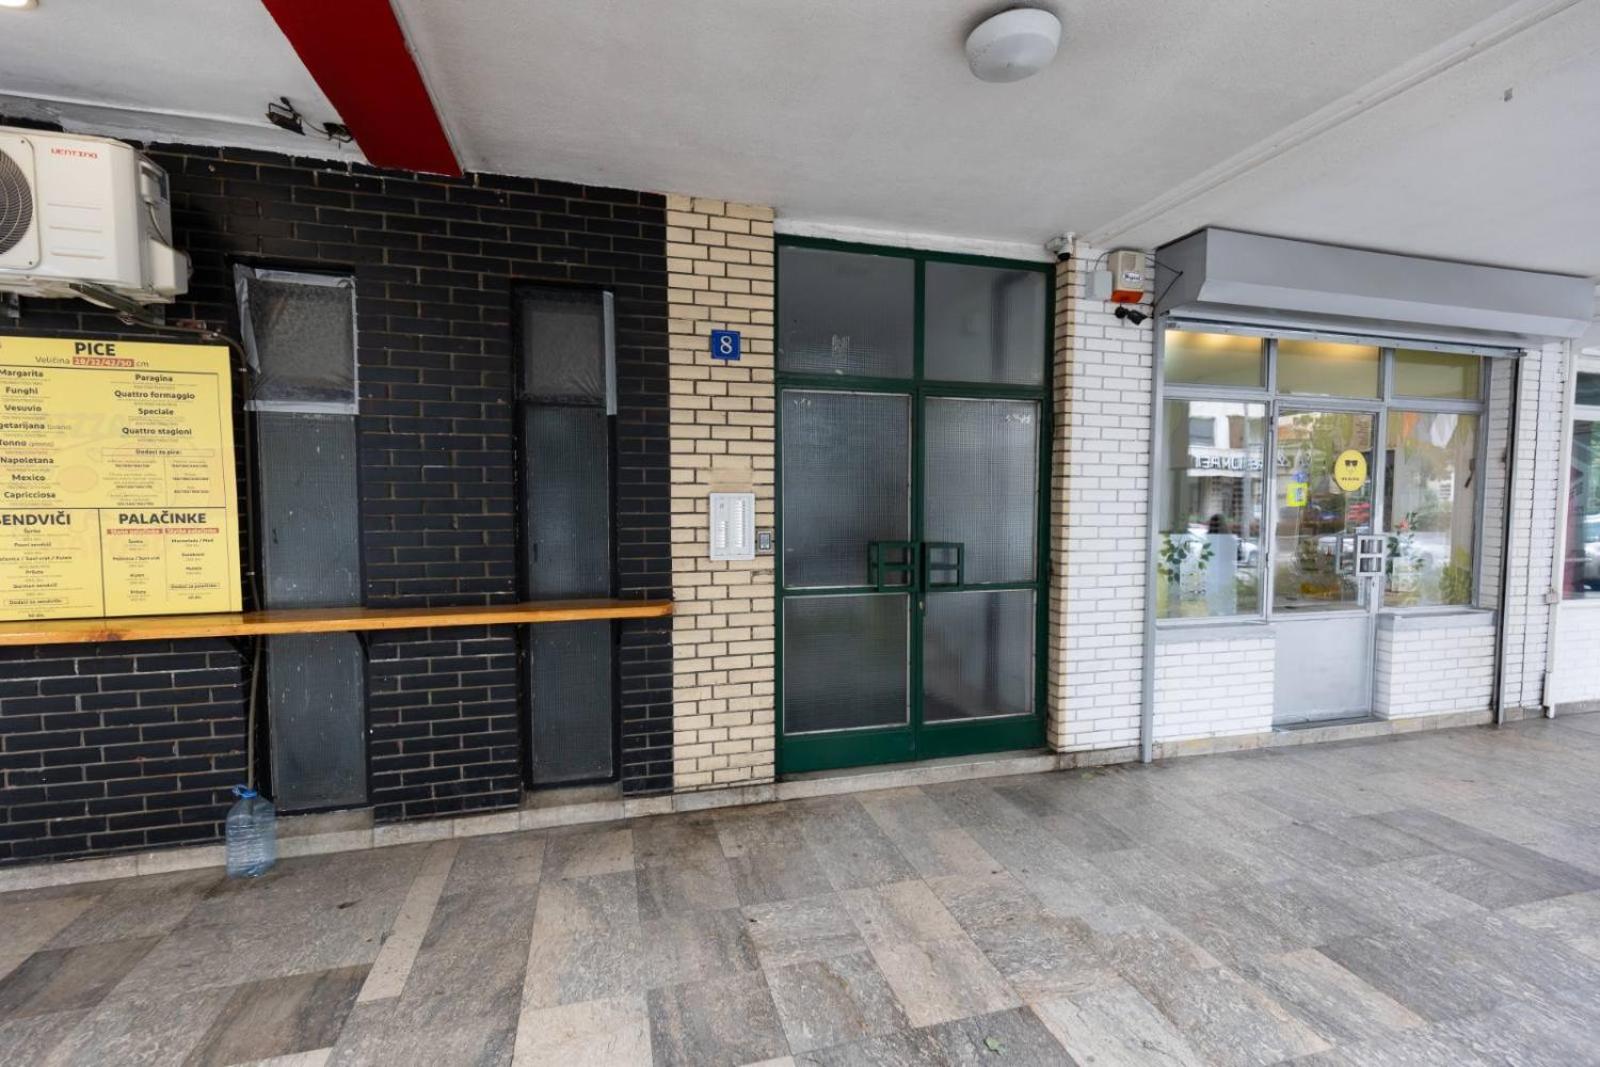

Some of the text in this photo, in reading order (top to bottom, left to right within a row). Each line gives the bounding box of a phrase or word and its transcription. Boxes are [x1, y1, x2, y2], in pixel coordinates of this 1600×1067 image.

[74, 341, 116, 356] PICE
[720, 335, 733, 354] 8
[0, 369, 44, 378] Margarita
[5, 386, 39, 395] Funghi
[114, 390, 196, 400] Quattro formaggio
[4, 404, 42, 412] Vesuvio
[138, 407, 174, 416] Speciale
[121, 427, 192, 436] Quattro stagioni
[0, 456, 55, 465] Napoletana
[4, 491, 56, 499] Capricciosa
[118, 510, 207, 524] PALAČINKE
